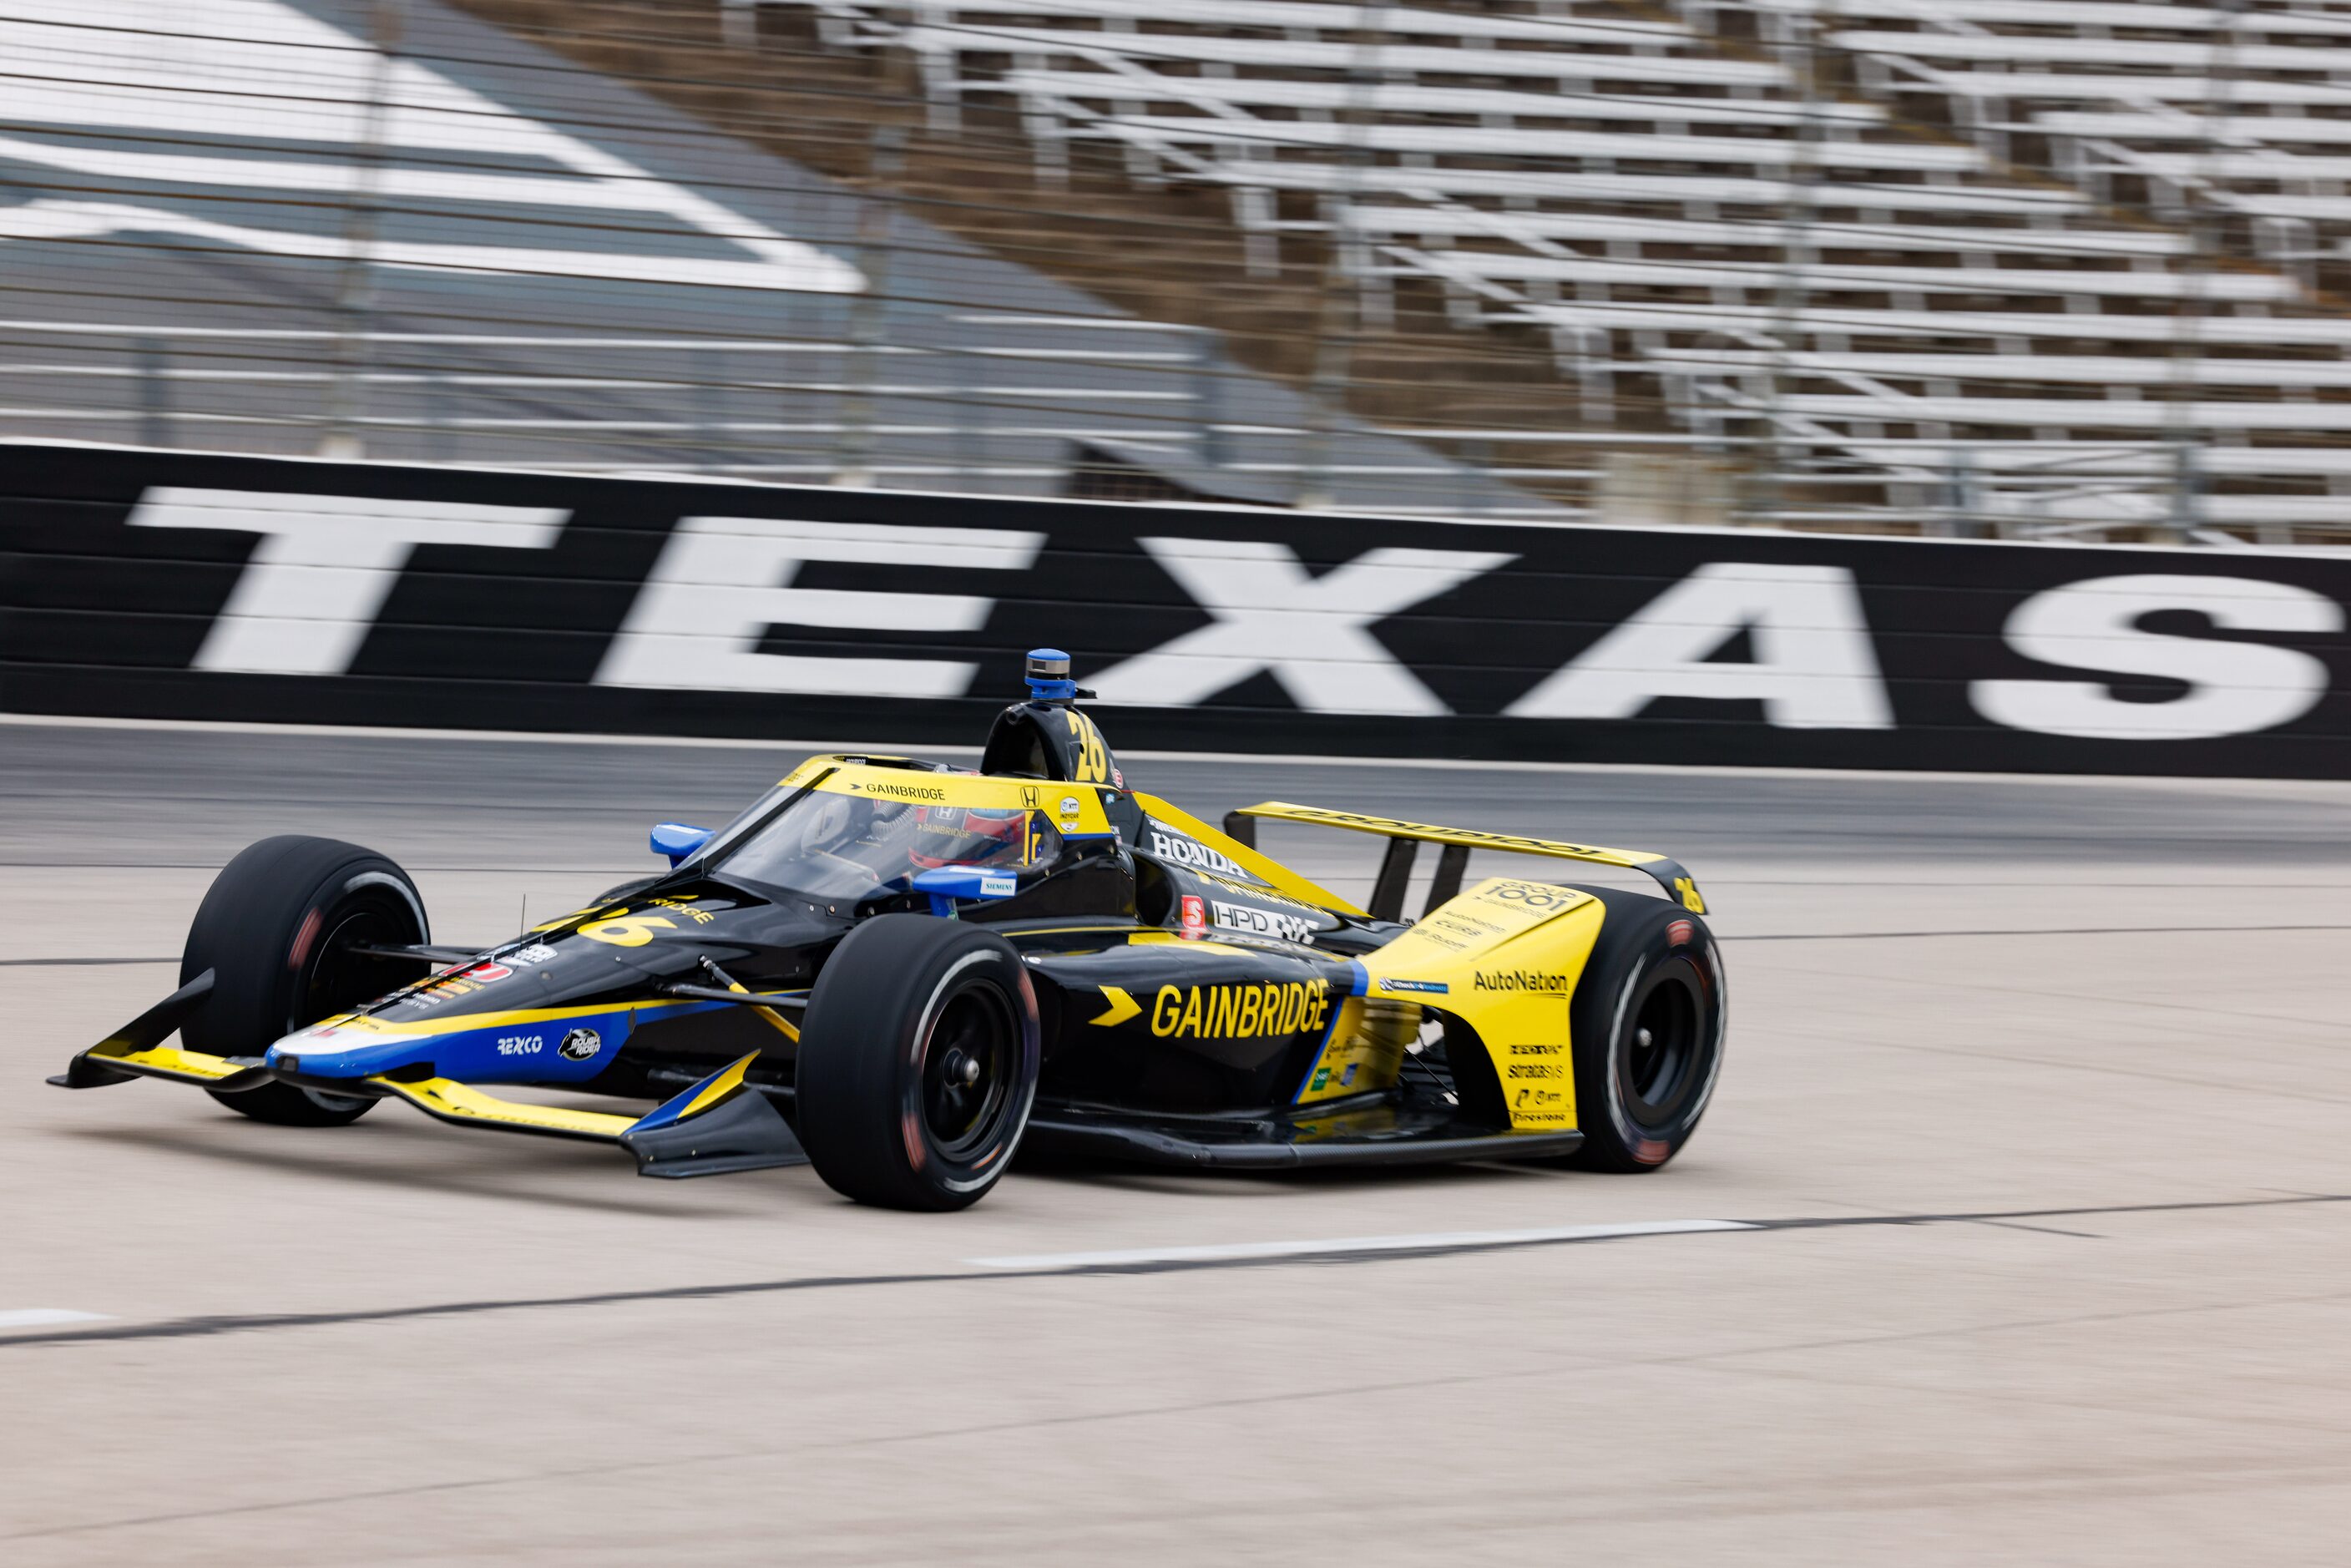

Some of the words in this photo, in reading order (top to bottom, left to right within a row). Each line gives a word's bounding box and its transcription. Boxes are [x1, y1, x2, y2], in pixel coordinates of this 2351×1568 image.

[128, 486, 2346, 740] TEXAS
[1066, 711, 1107, 783] 26
[866, 783, 946, 801] GAINBRIDGE
[1150, 832, 1249, 879] HONDA
[985, 883, 1013, 891] SIEMENS
[1484, 886, 1568, 912] 1001
[1500, 882, 1576, 898] GROUP
[1674, 877, 1705, 914] 26
[1215, 904, 1269, 932] HPD
[1474, 969, 1568, 992] AutoNation
[1150, 978, 1330, 1039] GAINBRIDGE
[497, 1035, 544, 1055] REXCO
